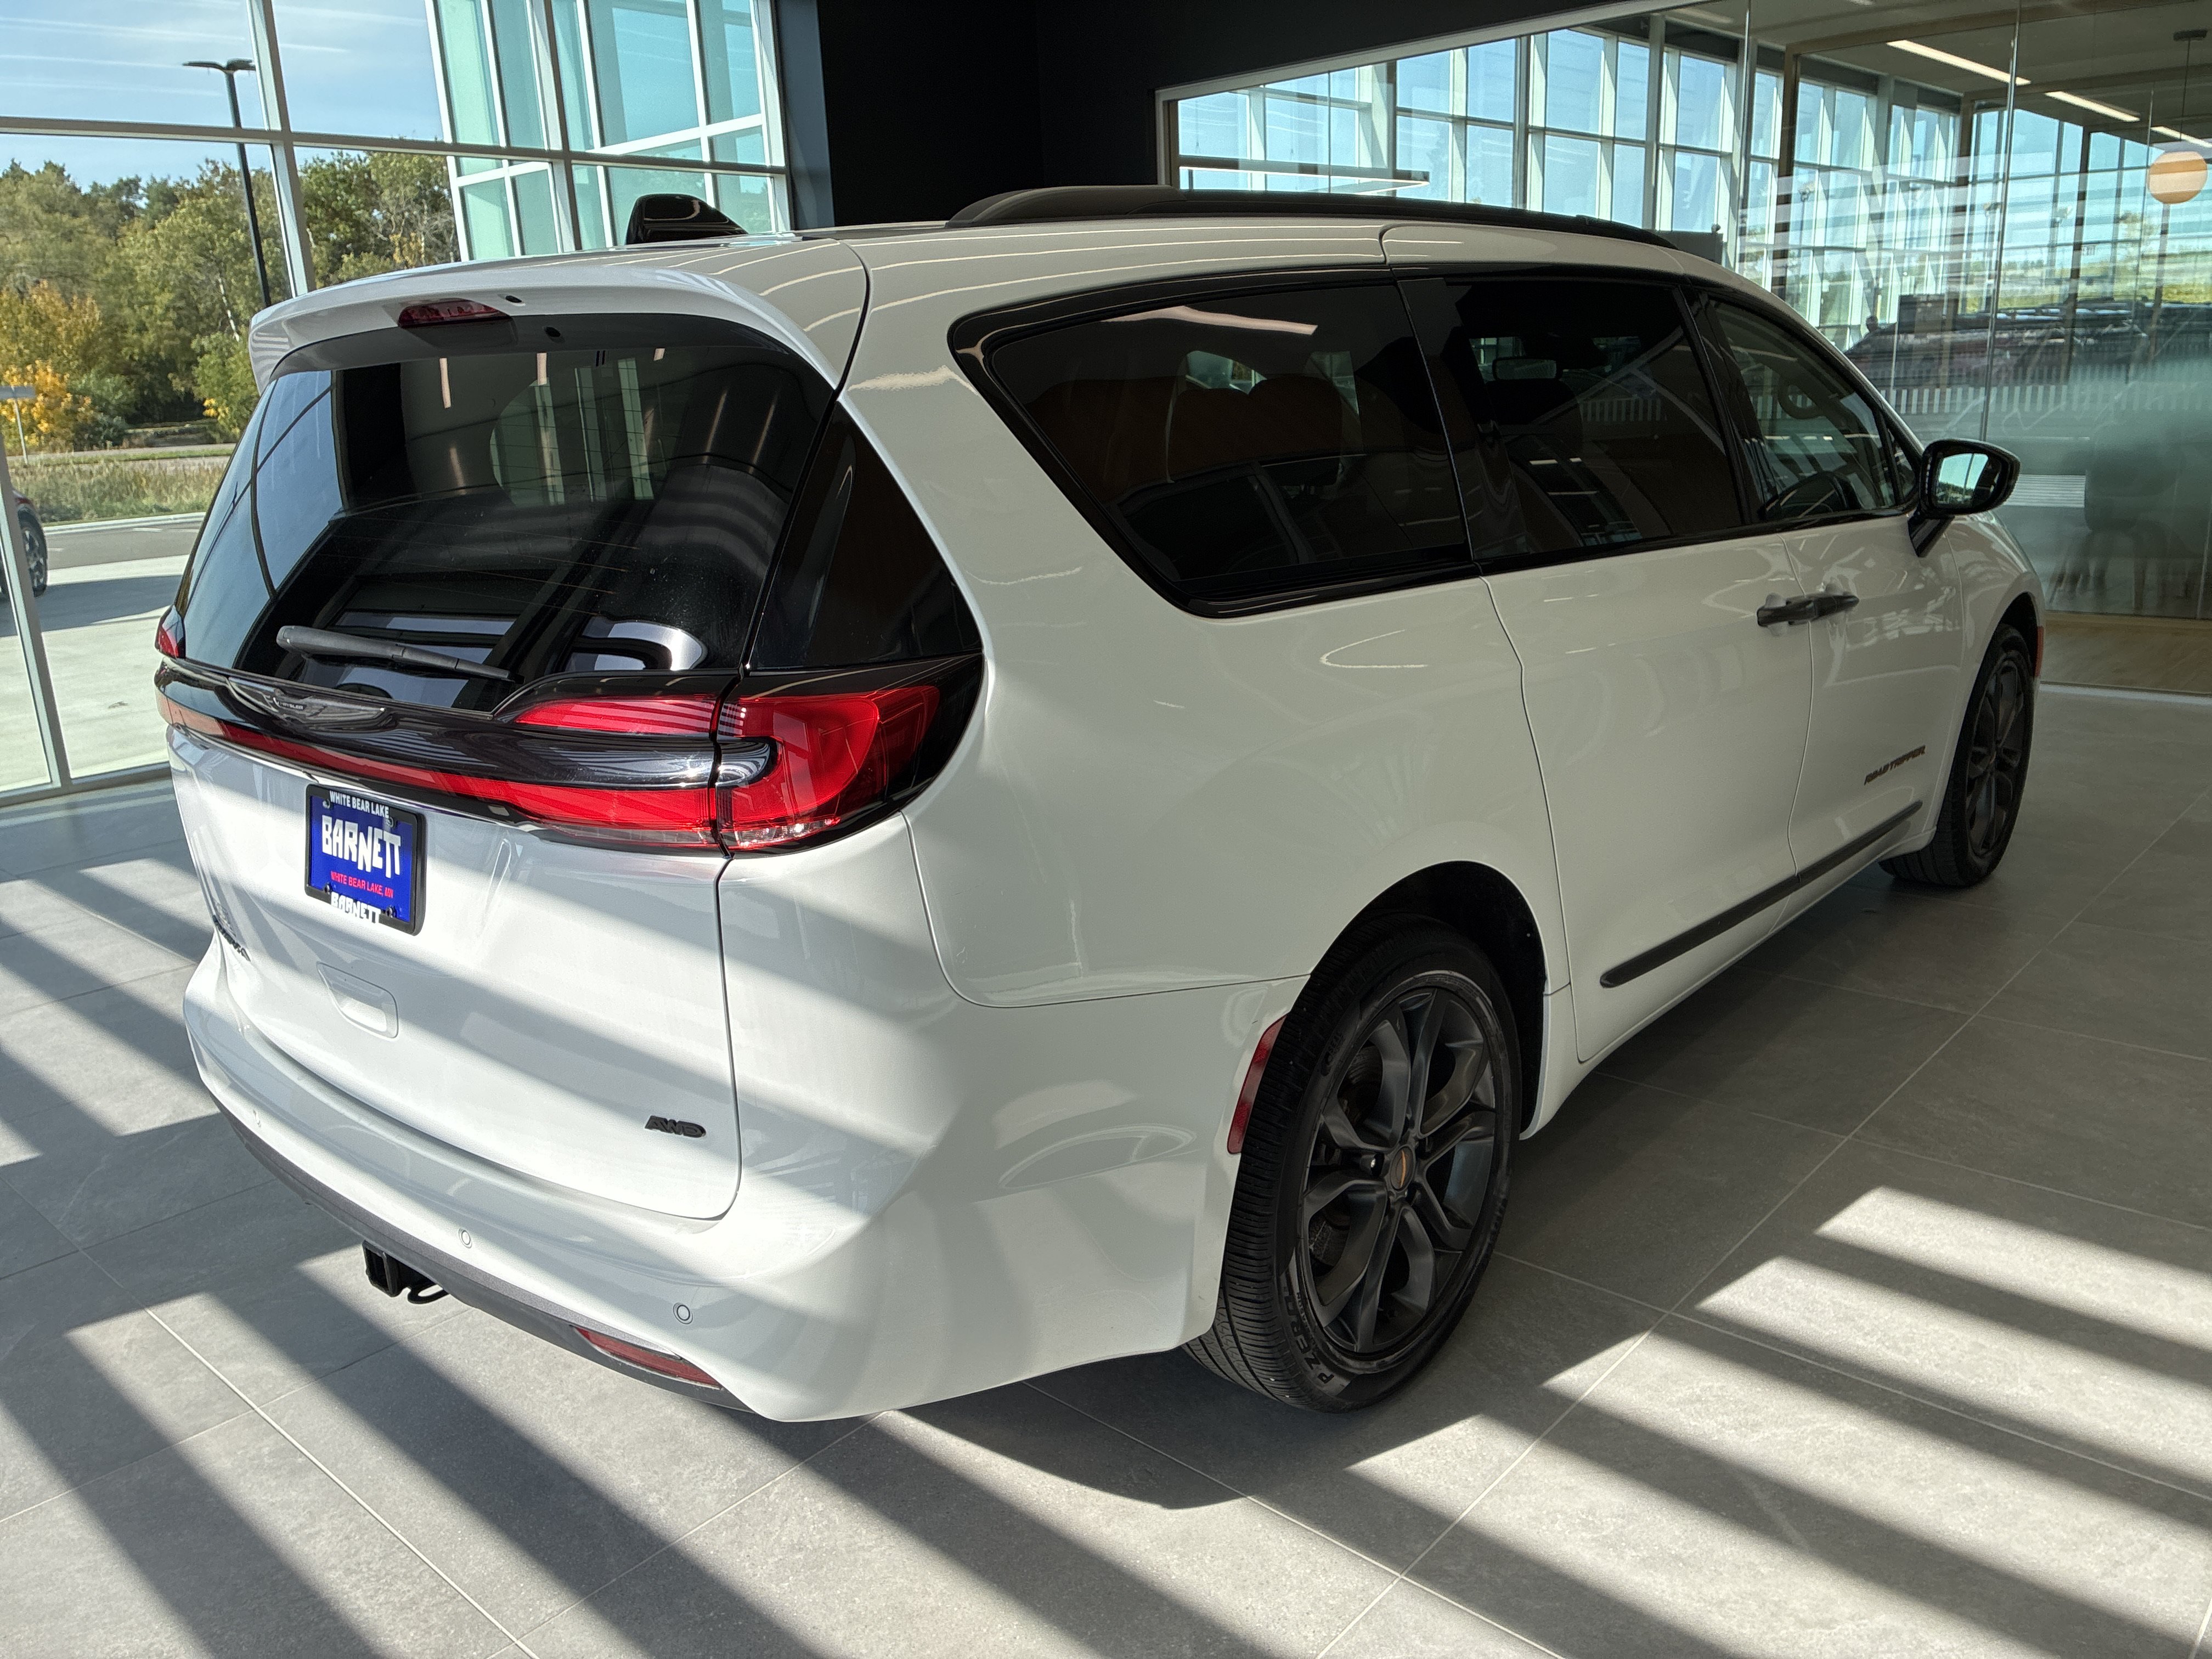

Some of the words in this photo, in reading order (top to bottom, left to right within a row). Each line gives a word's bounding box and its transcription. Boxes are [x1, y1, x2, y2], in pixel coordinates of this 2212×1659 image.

[329, 791, 351, 807] WHITE
[352, 796, 370, 814] BEAR
[371, 802, 389, 819] LAKE
[321, 815, 401, 878] BARNETT
[330, 871, 347, 885] WHITE
[348, 875, 366, 889] BEAR
[331, 891, 381, 923] BARNETT
[645, 1115, 706, 1138] AWD
